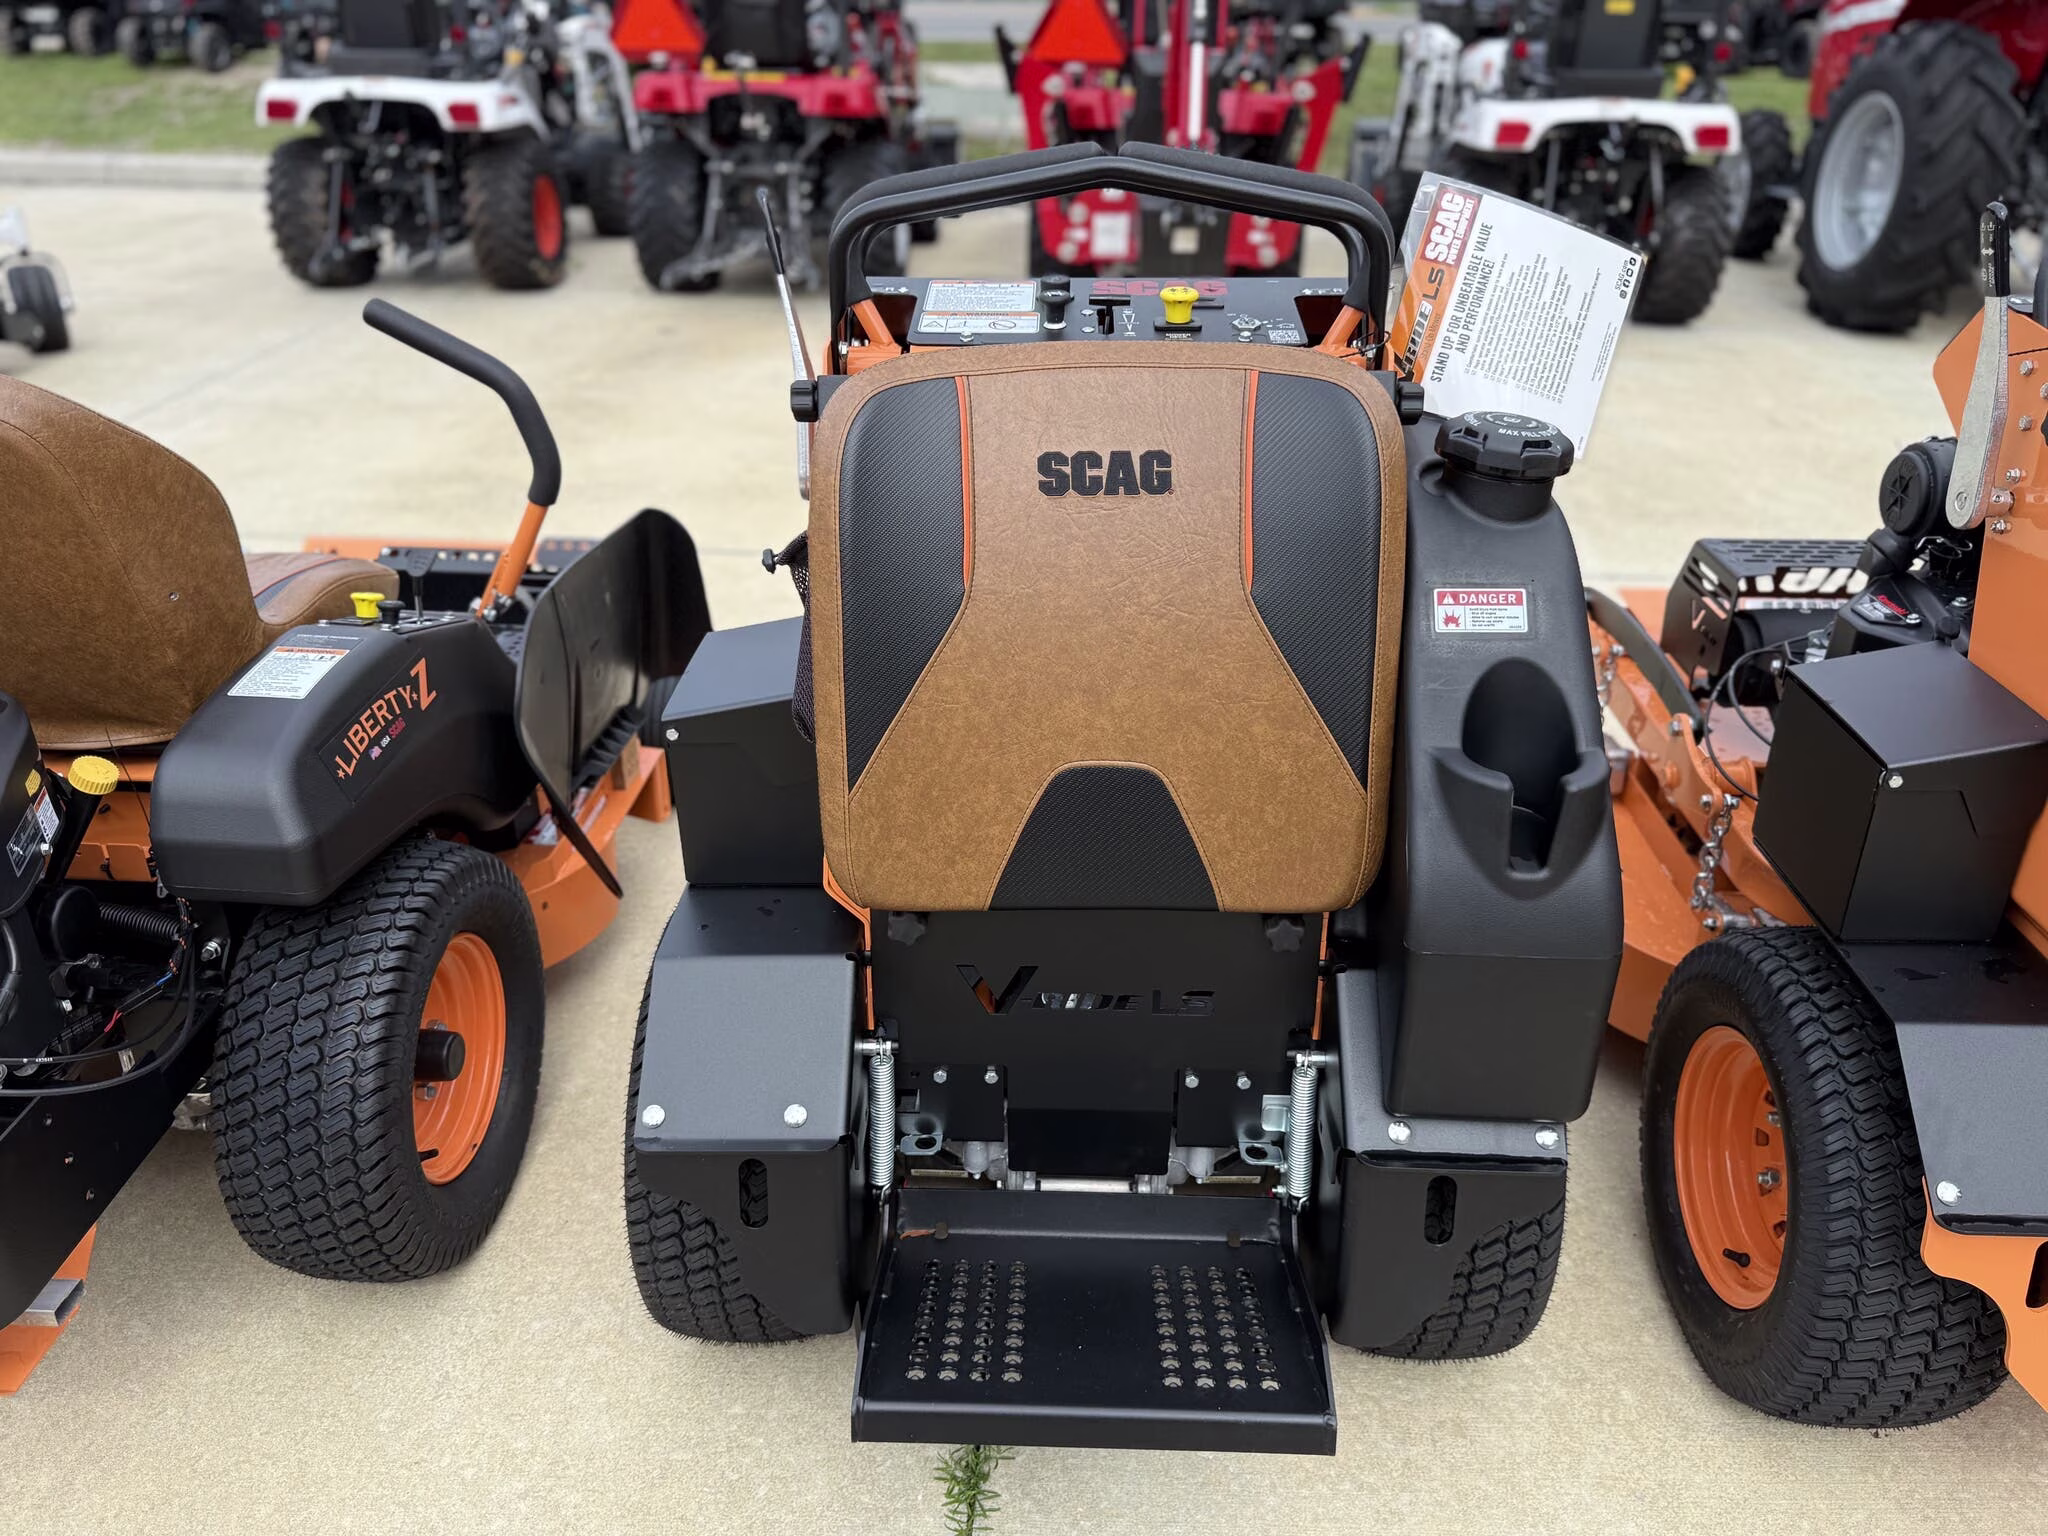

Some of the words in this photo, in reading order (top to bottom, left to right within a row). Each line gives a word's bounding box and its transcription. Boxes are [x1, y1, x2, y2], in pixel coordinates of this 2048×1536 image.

[1424, 192, 1465, 262] SCAG
[1446, 238, 1462, 265] POWER
[1455, 198, 1475, 239] EQUIPMENT
[1474, 223, 1493, 252] VALUE
[1423, 266, 1445, 300] LS
[1453, 253, 1483, 313] UNBEATABLE
[1460, 258, 1495, 332] PERFORMANCE!
[1446, 314, 1462, 334] FOR
[1441, 336, 1454, 351] UP
[1454, 332, 1470, 353] AND
[1430, 352, 1449, 382] STAND
[1498, 428, 1519, 436] MAX
[1037, 450, 1172, 496] SCAG
[1459, 593, 1516, 604] DANGER
[335, 685, 412, 776] LIBERTY
[410, 657, 437, 711] Z
[1152, 990, 1215, 1016] LS
